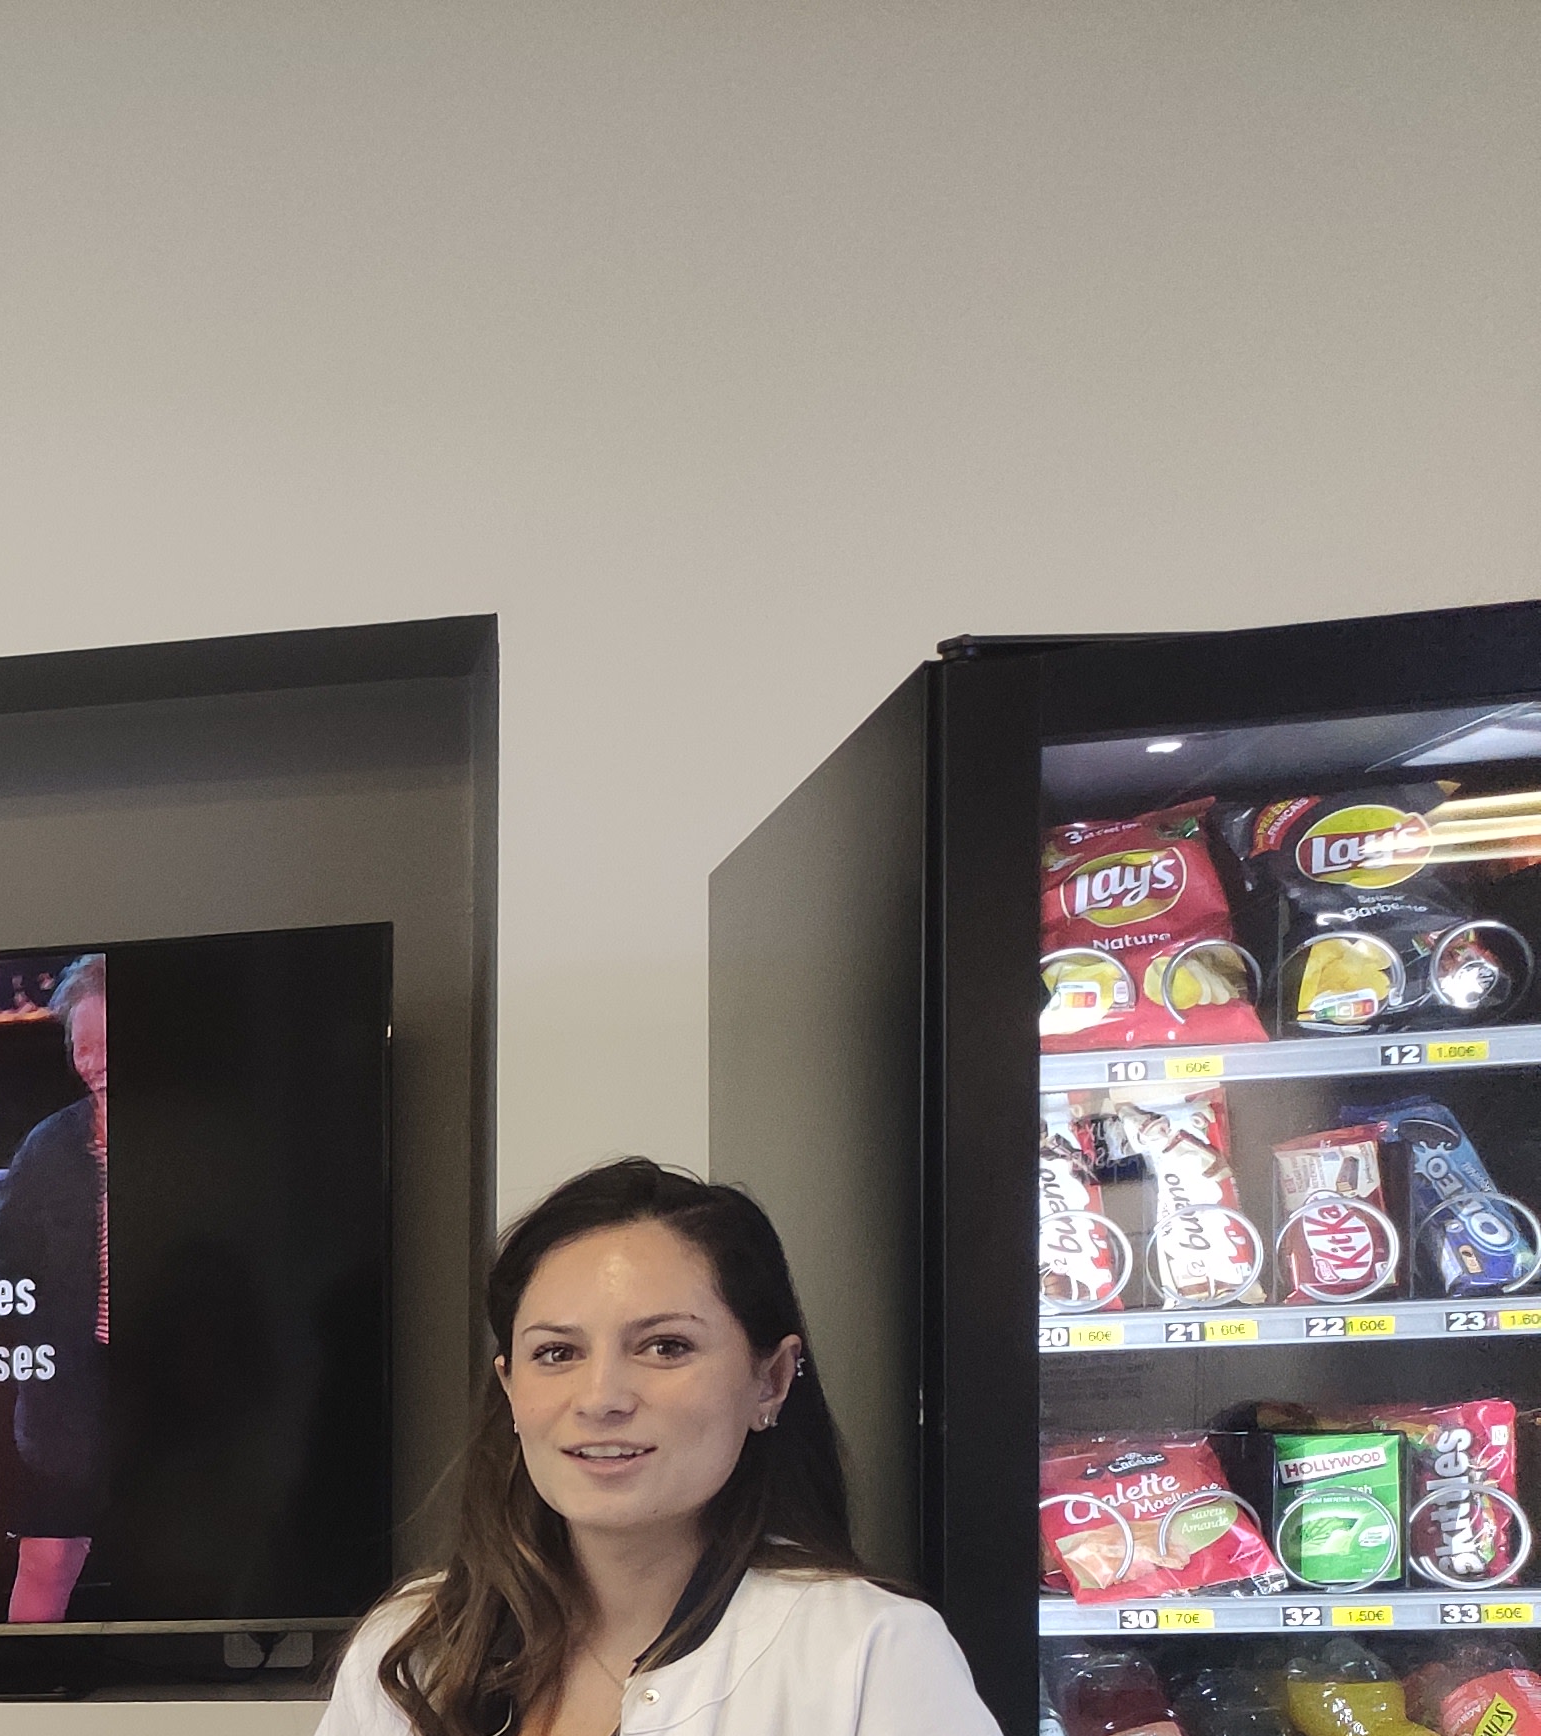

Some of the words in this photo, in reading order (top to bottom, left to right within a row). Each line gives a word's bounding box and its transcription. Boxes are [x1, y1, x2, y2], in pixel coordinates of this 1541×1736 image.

[1075, 856, 1175, 914] Lay's
[1093, 933, 1171, 950] Nature
[1385, 1046, 1421, 1065] 12
[1111, 1061, 1146, 1081] 10
[1303, 1204, 1371, 1270] KitKa
[1309, 1318, 1345, 1337] 22
[1449, 1311, 1485, 1332] 23
[1039, 1327, 1069, 1347] 20
[1168, 1322, 1203, 1342] 21
[1284, 1451, 1381, 1479] HOLLYWOOD
[1122, 1610, 1156, 1628] 30
[1286, 1608, 1321, 1626] 32
[1443, 1605, 1480, 1623] 33
